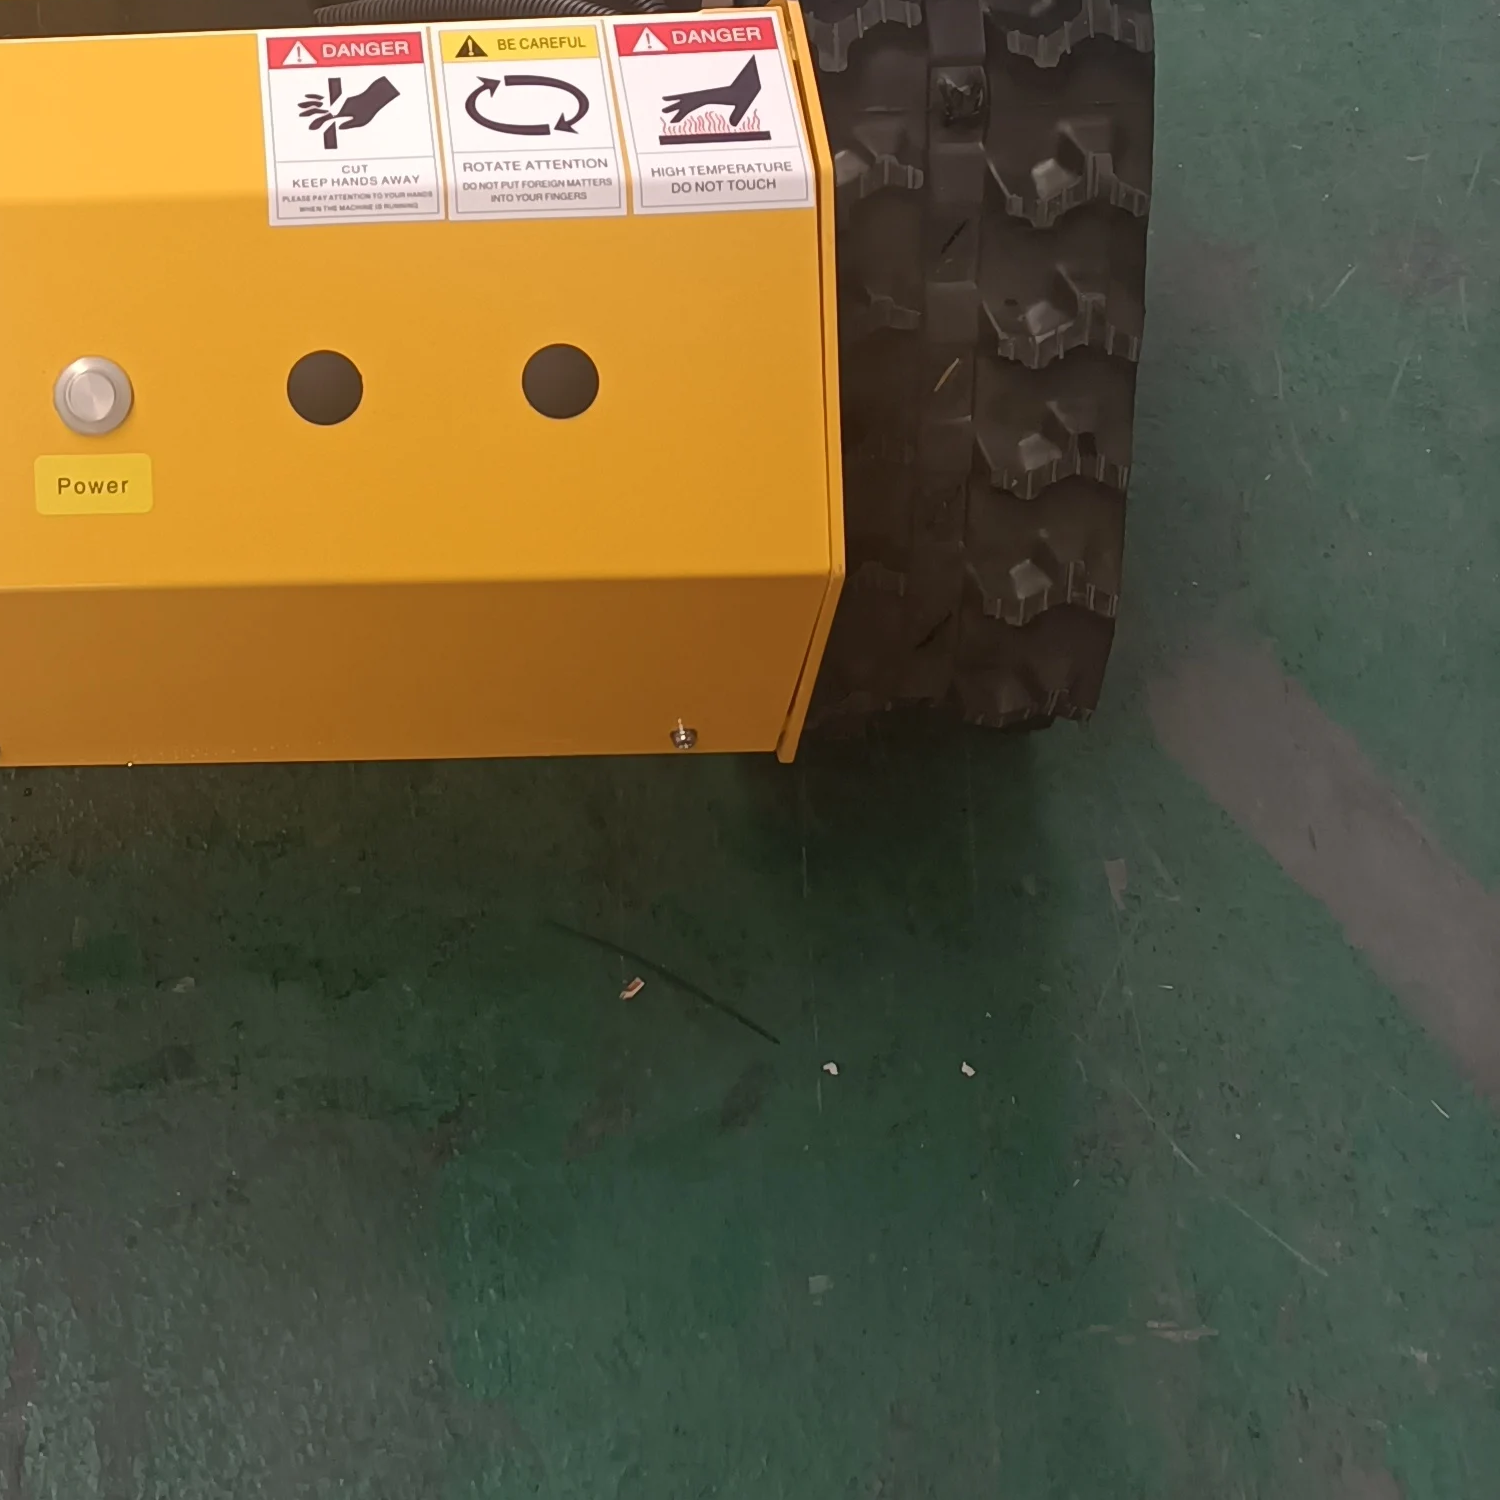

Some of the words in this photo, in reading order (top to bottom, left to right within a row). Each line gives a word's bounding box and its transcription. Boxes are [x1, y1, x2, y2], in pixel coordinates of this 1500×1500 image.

[497, 37, 516, 51] BE
[519, 35, 587, 51] CAREFUL
[671, 25, 762, 46] DANGER
[322, 39, 410, 60] DANGER
[341, 164, 368, 174] CUT
[463, 160, 521, 172] ROTATE
[525, 158, 608, 170] ATTENTION
[651, 166, 686, 177] HIGH
[688, 161, 793, 176] TEMPERATURE
[292, 178, 328, 188] KEEP
[331, 176, 378, 187] HANDS
[381, 175, 420, 185] AWAY
[462, 182, 477, 190] DO
[479, 181, 499, 190] NOT
[501, 180, 519, 189] PUT
[522, 179, 565, 188] FOREIGN
[567, 178, 613, 187] MATTERS
[671, 182, 691, 194] DO
[695, 180, 725, 193] NOT
[726, 178, 777, 191] TOUCH
[329, 192, 371, 201] ATTENTION
[384, 191, 406, 199] YOUR
[491, 194, 513, 202] INTO
[515, 193, 543, 202] YOUR
[545, 191, 587, 201] FINGERS
[57, 476, 130, 496] Power
